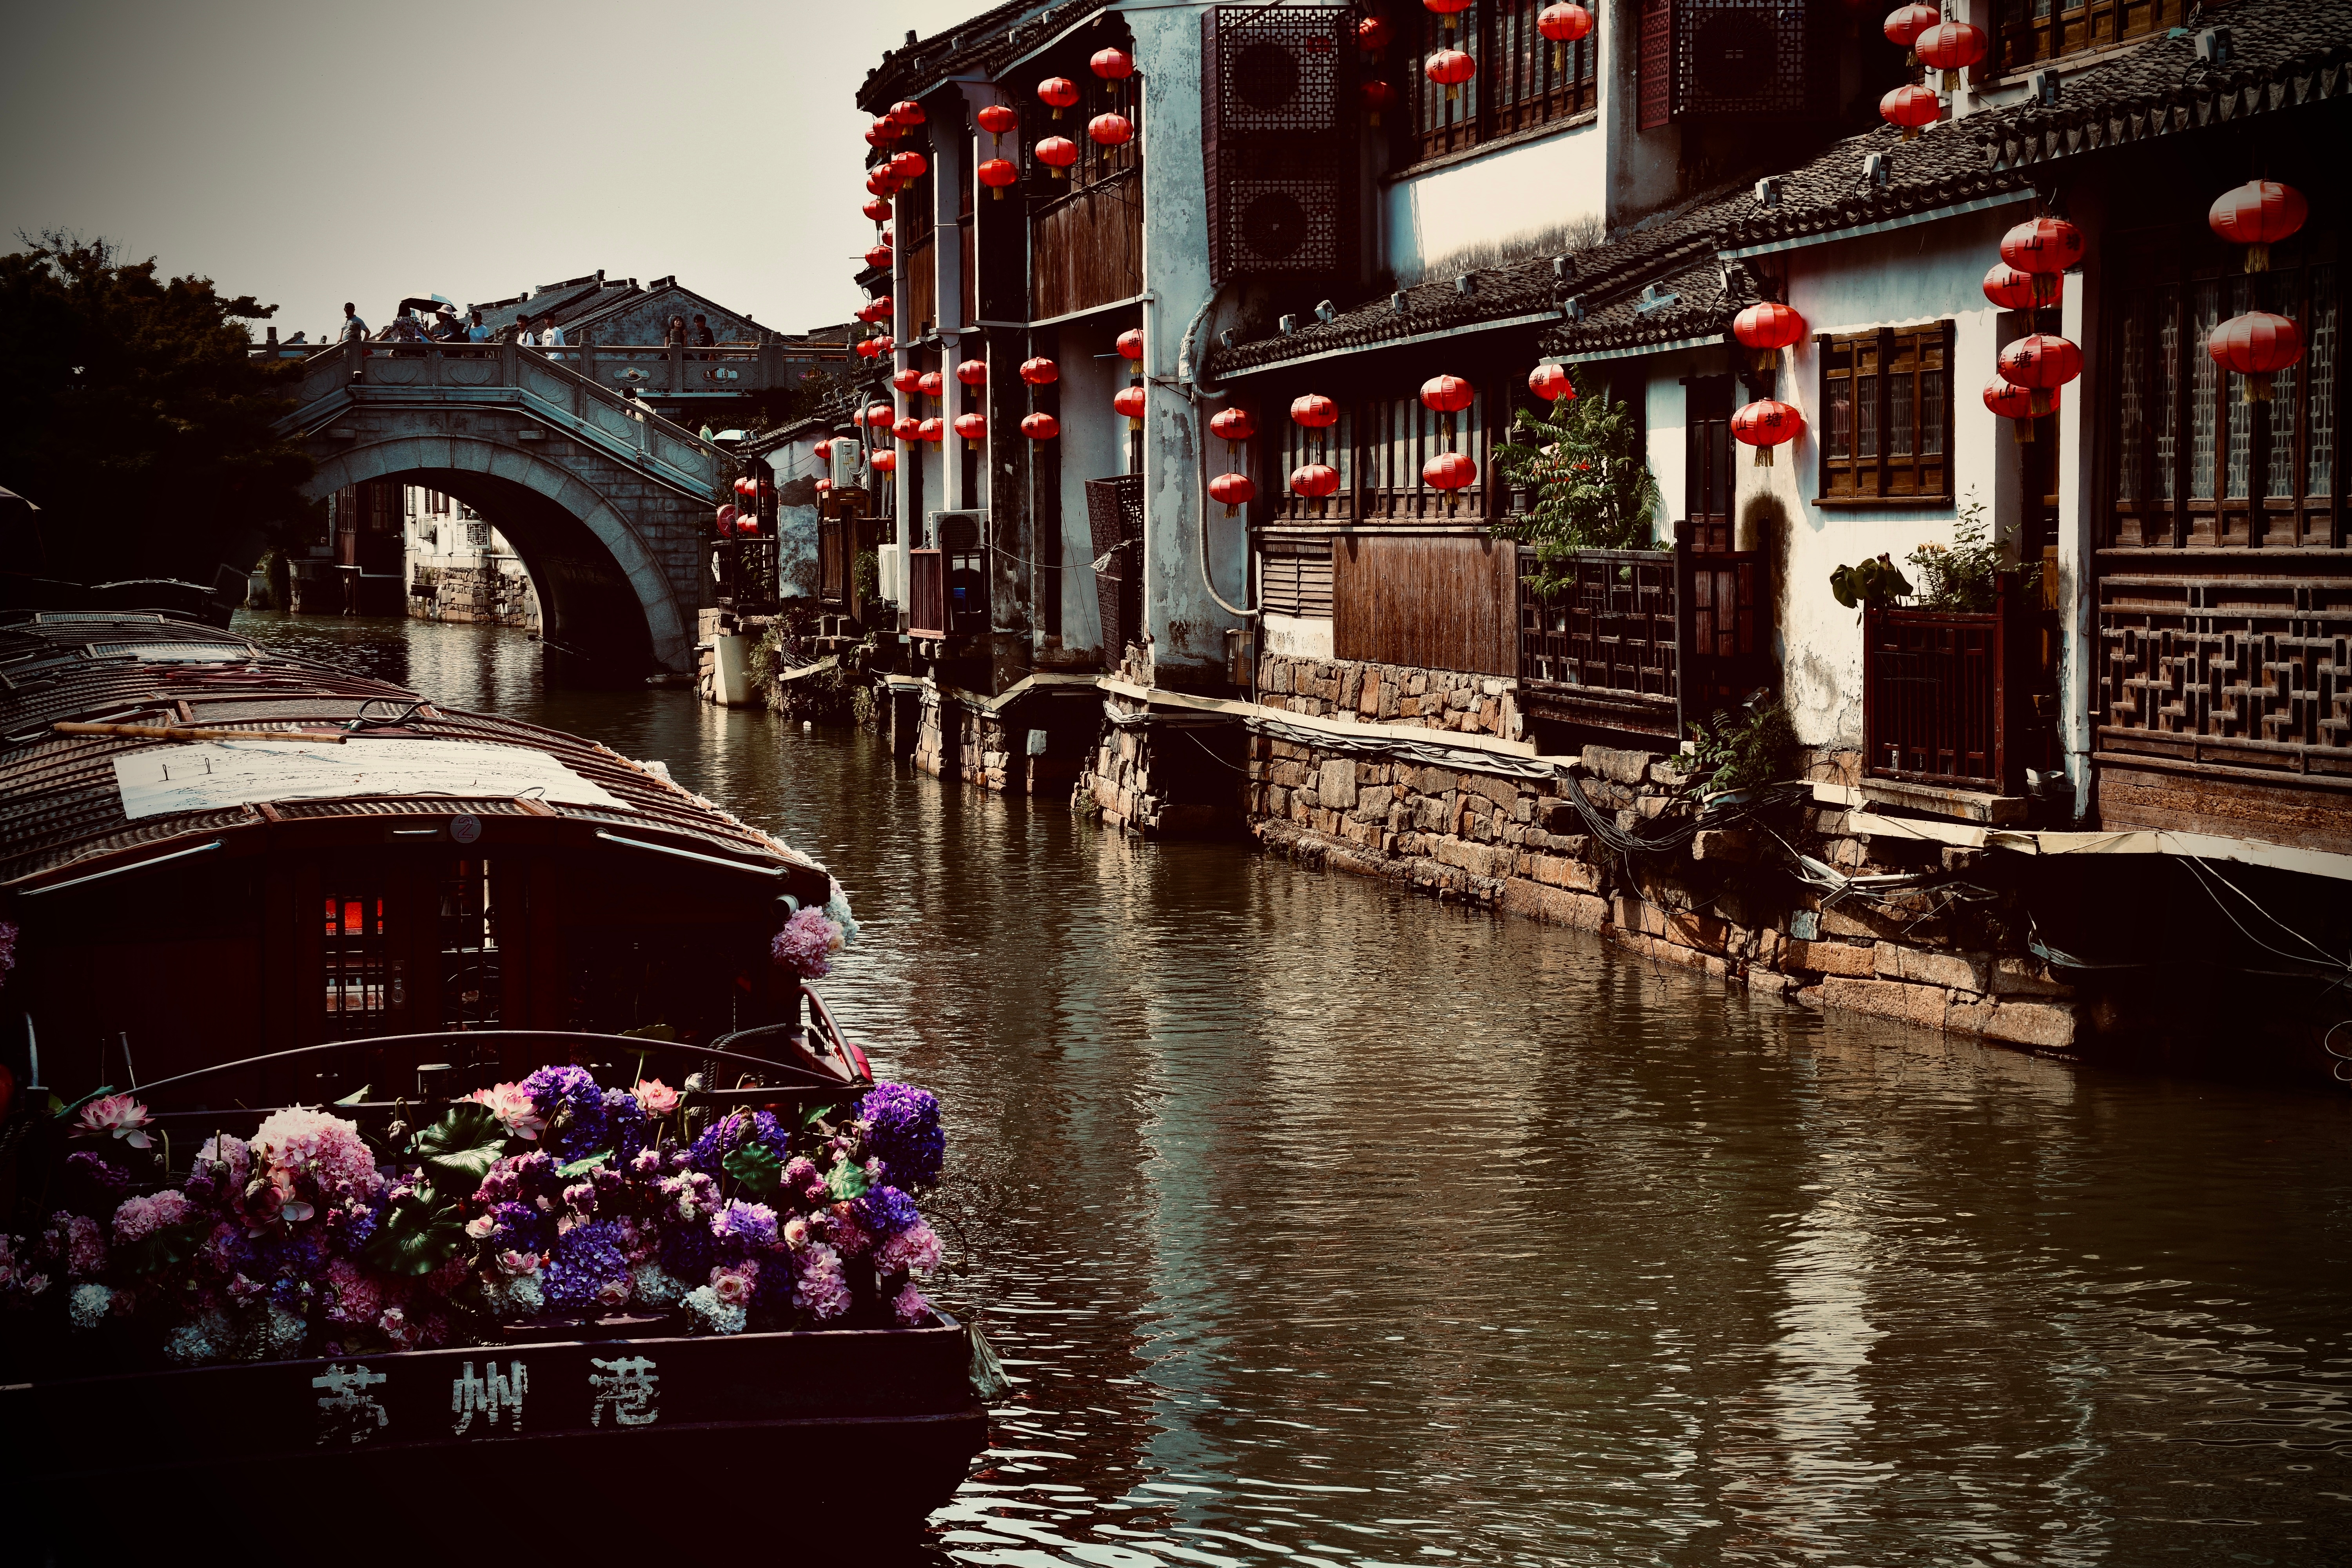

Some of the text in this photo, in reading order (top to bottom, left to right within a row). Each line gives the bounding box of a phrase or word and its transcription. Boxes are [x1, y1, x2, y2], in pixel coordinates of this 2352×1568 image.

[1544, 12, 1555, 24] 塘
[1433, 60, 1444, 71] 塘
[1058, 84, 1068, 94] 山
[1128, 337, 1140, 347] 塘
[1533, 373, 1545, 386] 塘
[1318, 405, 1329, 416] 山
[1025, 421, 1034, 430] 塘
[1229, 418, 1240, 427] 山
[1295, 474, 1306, 485] 塘
[457, 817, 474, 838] 2
